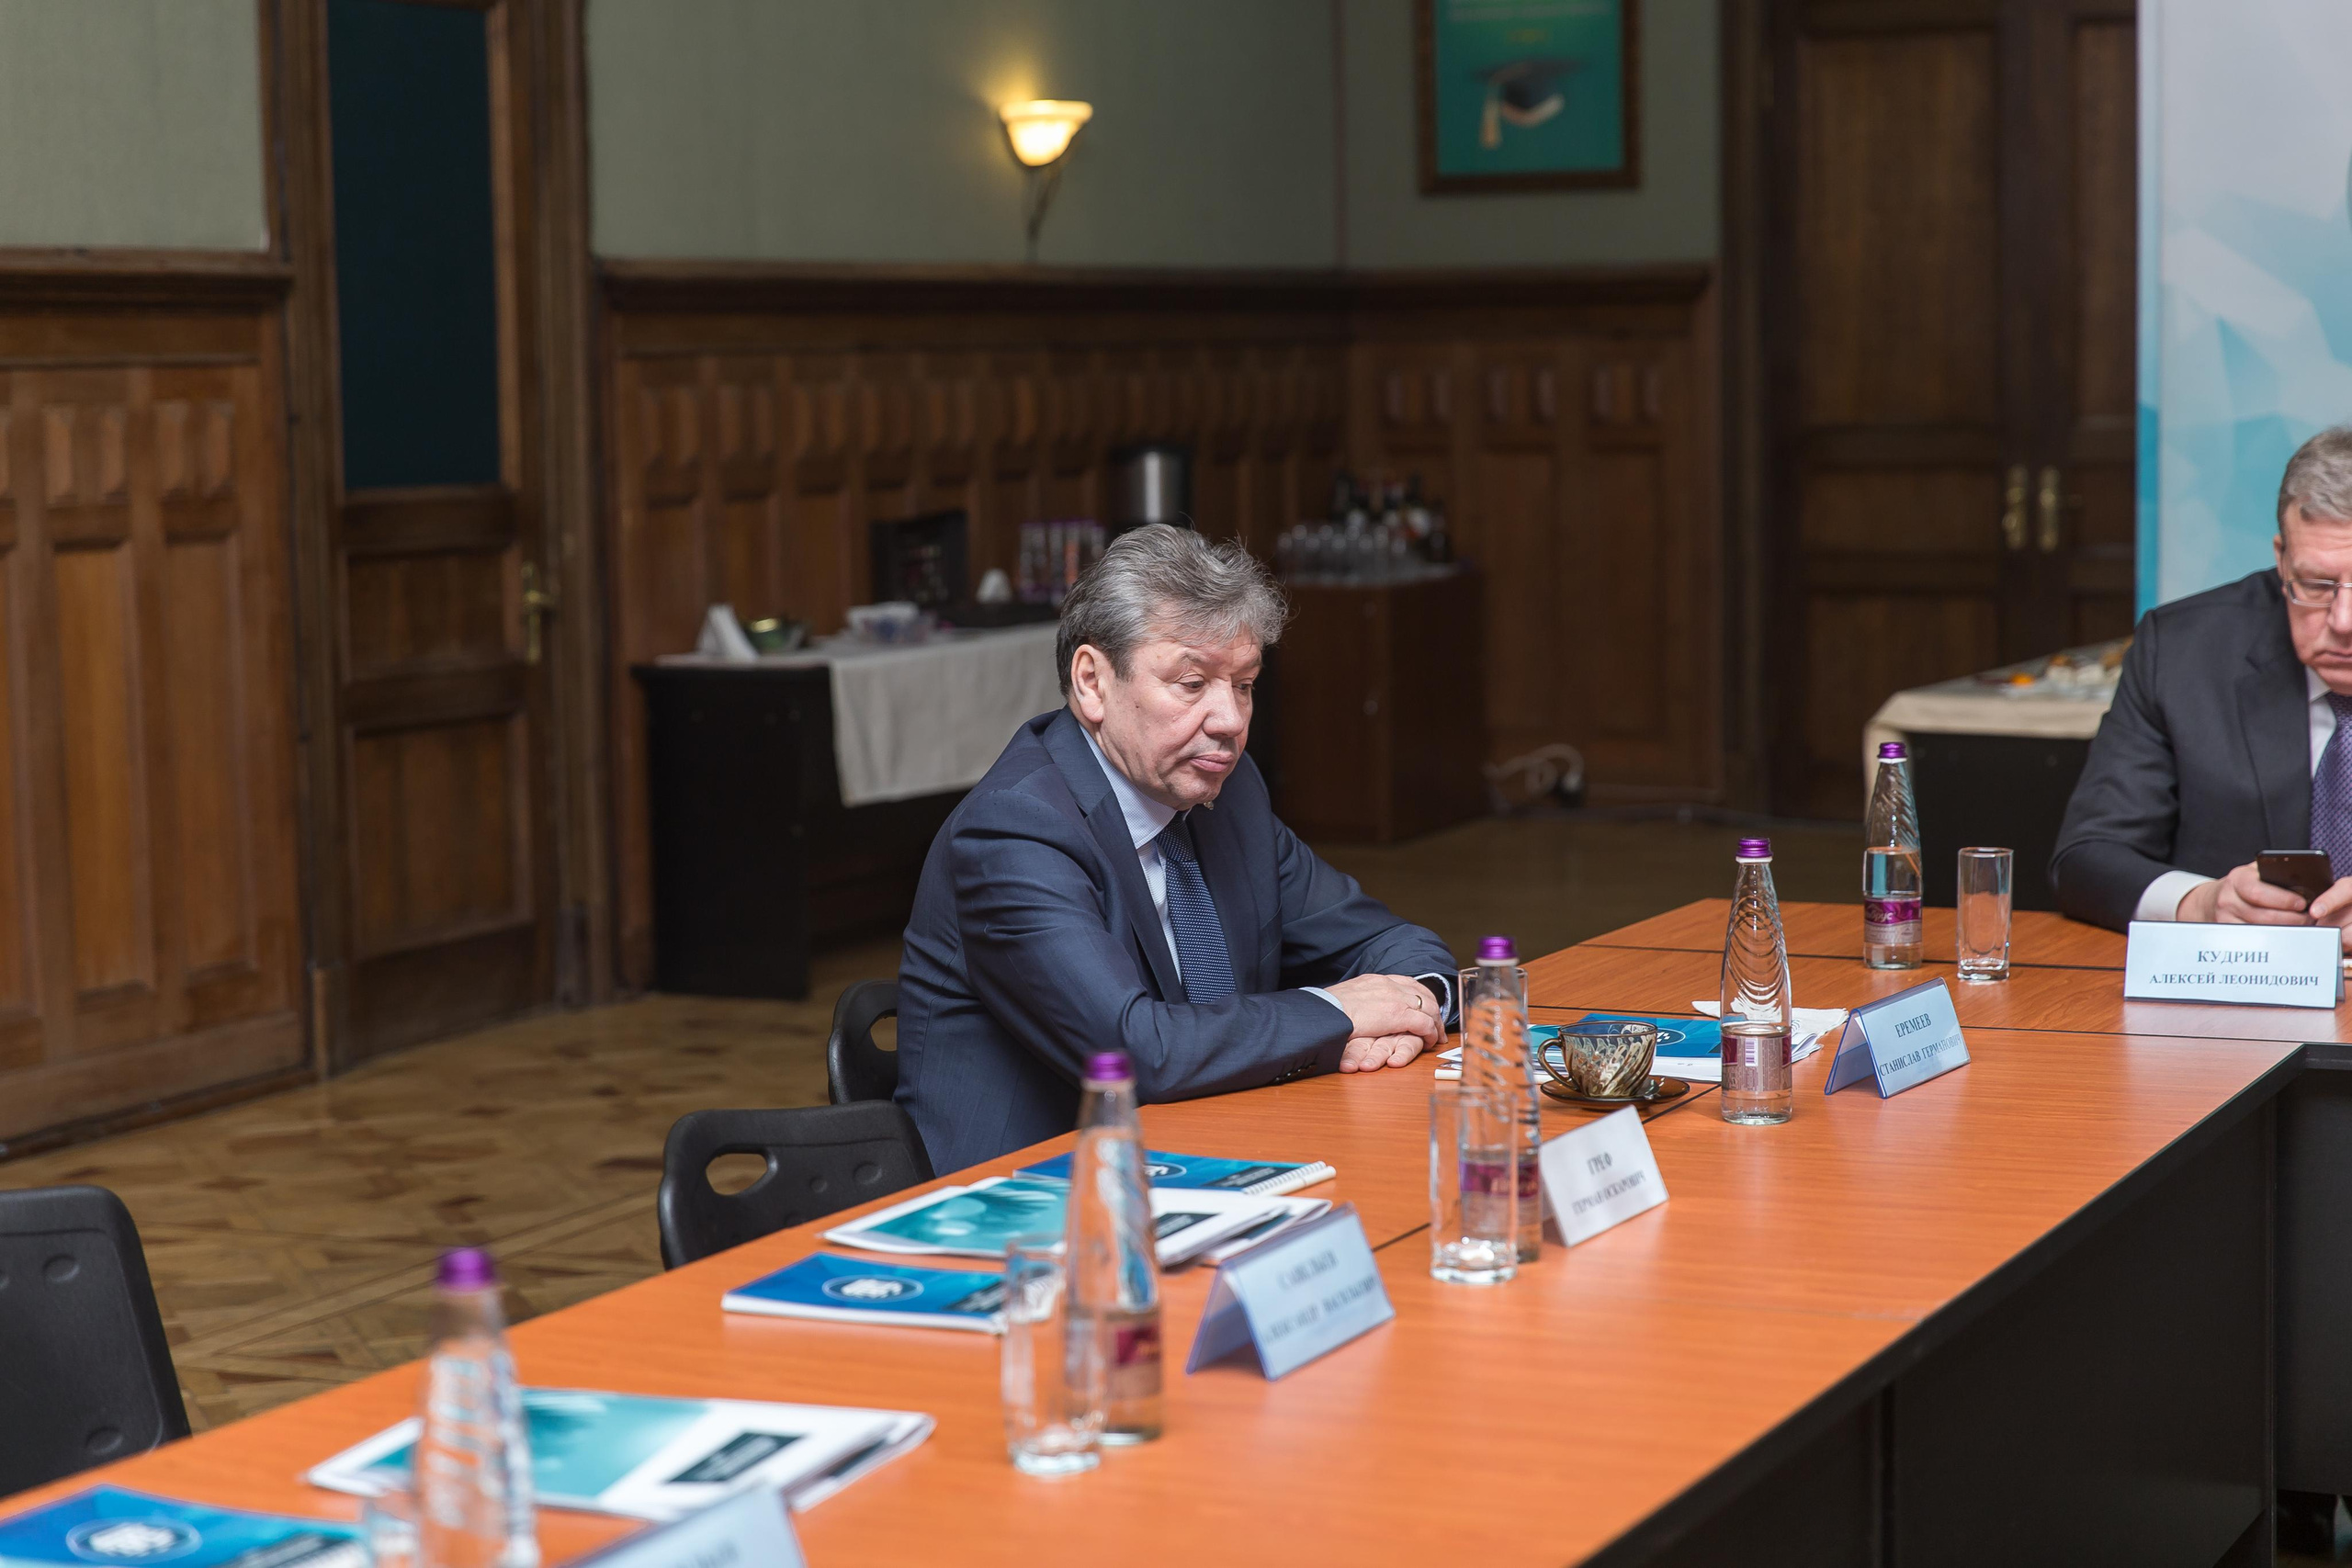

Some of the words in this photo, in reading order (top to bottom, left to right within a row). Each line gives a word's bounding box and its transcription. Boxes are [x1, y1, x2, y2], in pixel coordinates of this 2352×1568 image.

[2198, 950, 2269, 964] КУДРИН
[2149, 972, 2216, 985] АЛЕКСЕЙ
[2219, 974, 2319, 987] ЛЕОНИДОВИЧ
[1894, 1012, 1932, 1038] ЕРЕМЕЕВ
[1879, 1050, 1921, 1077] СТАНИСЛАВ
[1921, 1032, 1962, 1060] ГЕРМАНОВИЧ
